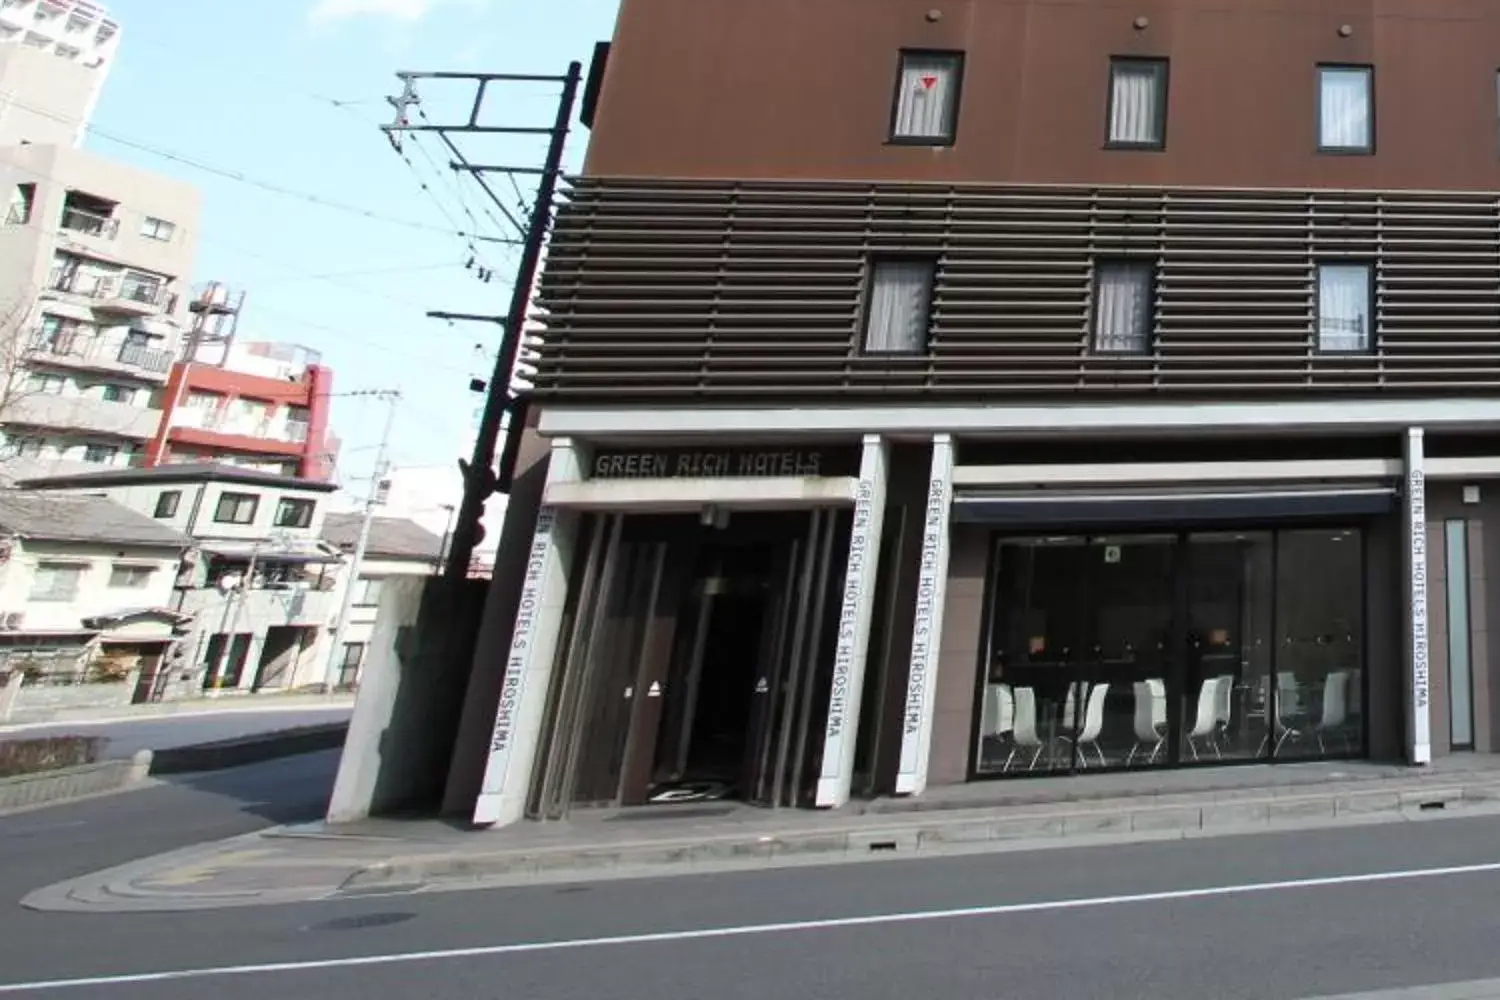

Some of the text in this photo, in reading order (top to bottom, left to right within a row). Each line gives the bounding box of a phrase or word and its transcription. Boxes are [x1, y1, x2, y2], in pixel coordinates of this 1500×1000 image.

[596, 451, 823, 475] GREEN RICH HOTELS
[527, 542, 547, 582] RICH
[827, 479, 873, 737] GREEN RICH HOTELS HIROSHIMA
[904, 479, 944, 735] GREEN RICH HOTELS HIROSHIMA
[1411, 470, 1427, 708] GREEN RICH HOTELS HIROSHIMA
[514, 584, 538, 650] HOTELS
[491, 656, 523, 752] HIROSHIMA
